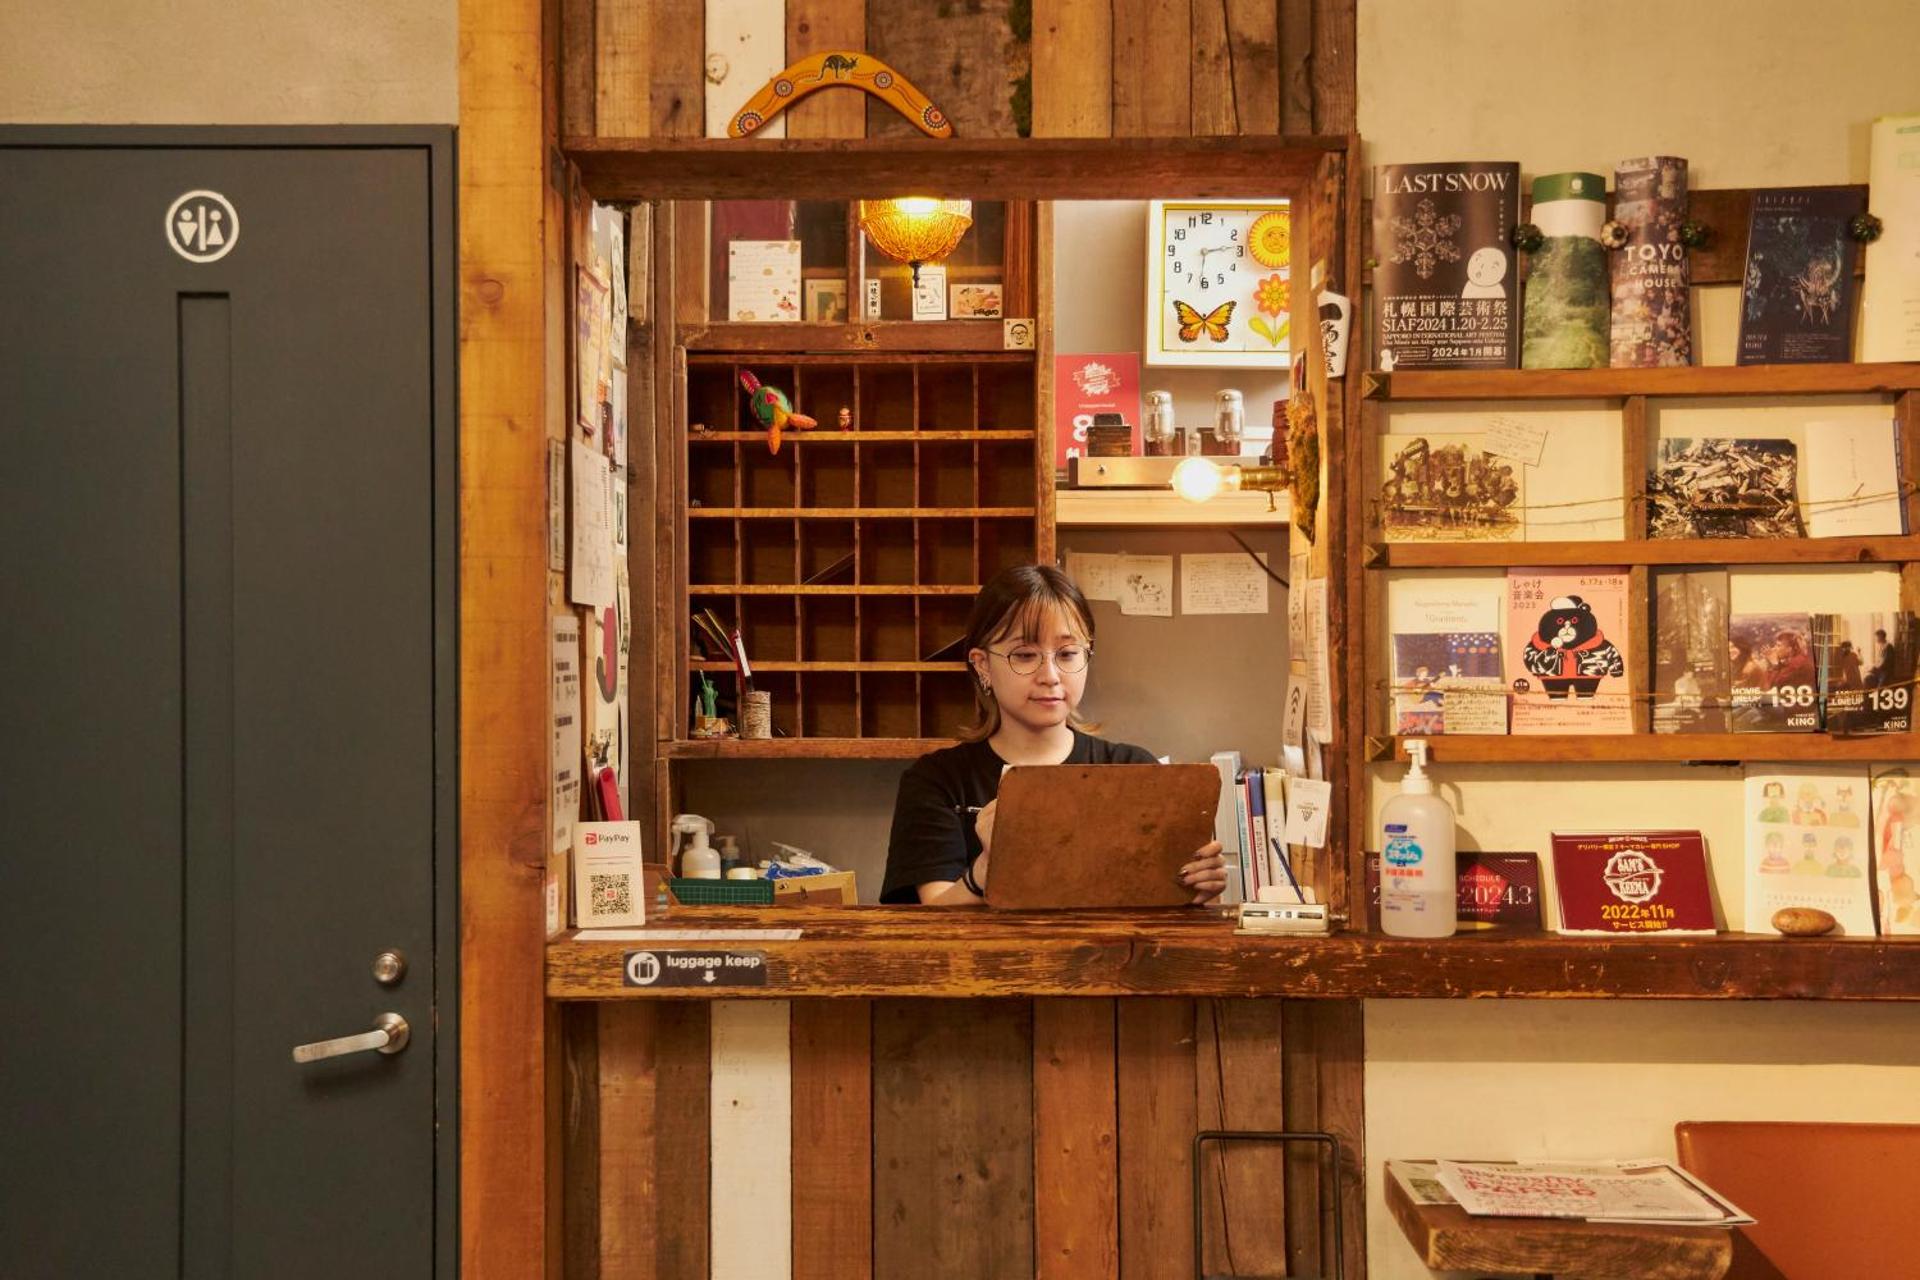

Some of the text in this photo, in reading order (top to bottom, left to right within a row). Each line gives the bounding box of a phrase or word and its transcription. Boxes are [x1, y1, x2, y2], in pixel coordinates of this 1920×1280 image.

[1385, 171, 1510, 194] LAST SNOW
[1188, 216, 1197, 228] 11
[1200, 212, 1212, 224] 12
[1220, 217, 1224, 226] 1
[1174, 228, 1186, 240] 10
[1230, 229, 1238, 241] 2
[1168, 244, 1175, 257] 9
[1236, 245, 1243, 257] 3
[1624, 243, 1683, 261] TOYO
[1174, 261, 1182, 273] 8
[1230, 263, 1236, 272] 4
[1187, 273, 1193, 284] 7
[1201, 277, 1209, 289] 6
[1217, 273, 1224, 285] 5
[1635, 278, 1677, 288] HOUSE
[1383, 301, 1508, 317] 札幌国際芸術祭
[1382, 317, 1508, 332] SIAF2024 1.20-2.25
[1513, 579, 1542, 589] しゃけ
[1512, 589, 1544, 600] 音楽会
[1766, 685, 1815, 708] 138
[1868, 688, 1908, 711] 139
[1787, 717, 1816, 726] KINO
[1883, 720, 1907, 729] KINO
[598, 834, 630, 844] PayPay
[1601, 904, 1675, 919] 2022年11月
[666, 954, 761, 969] luggage keep
